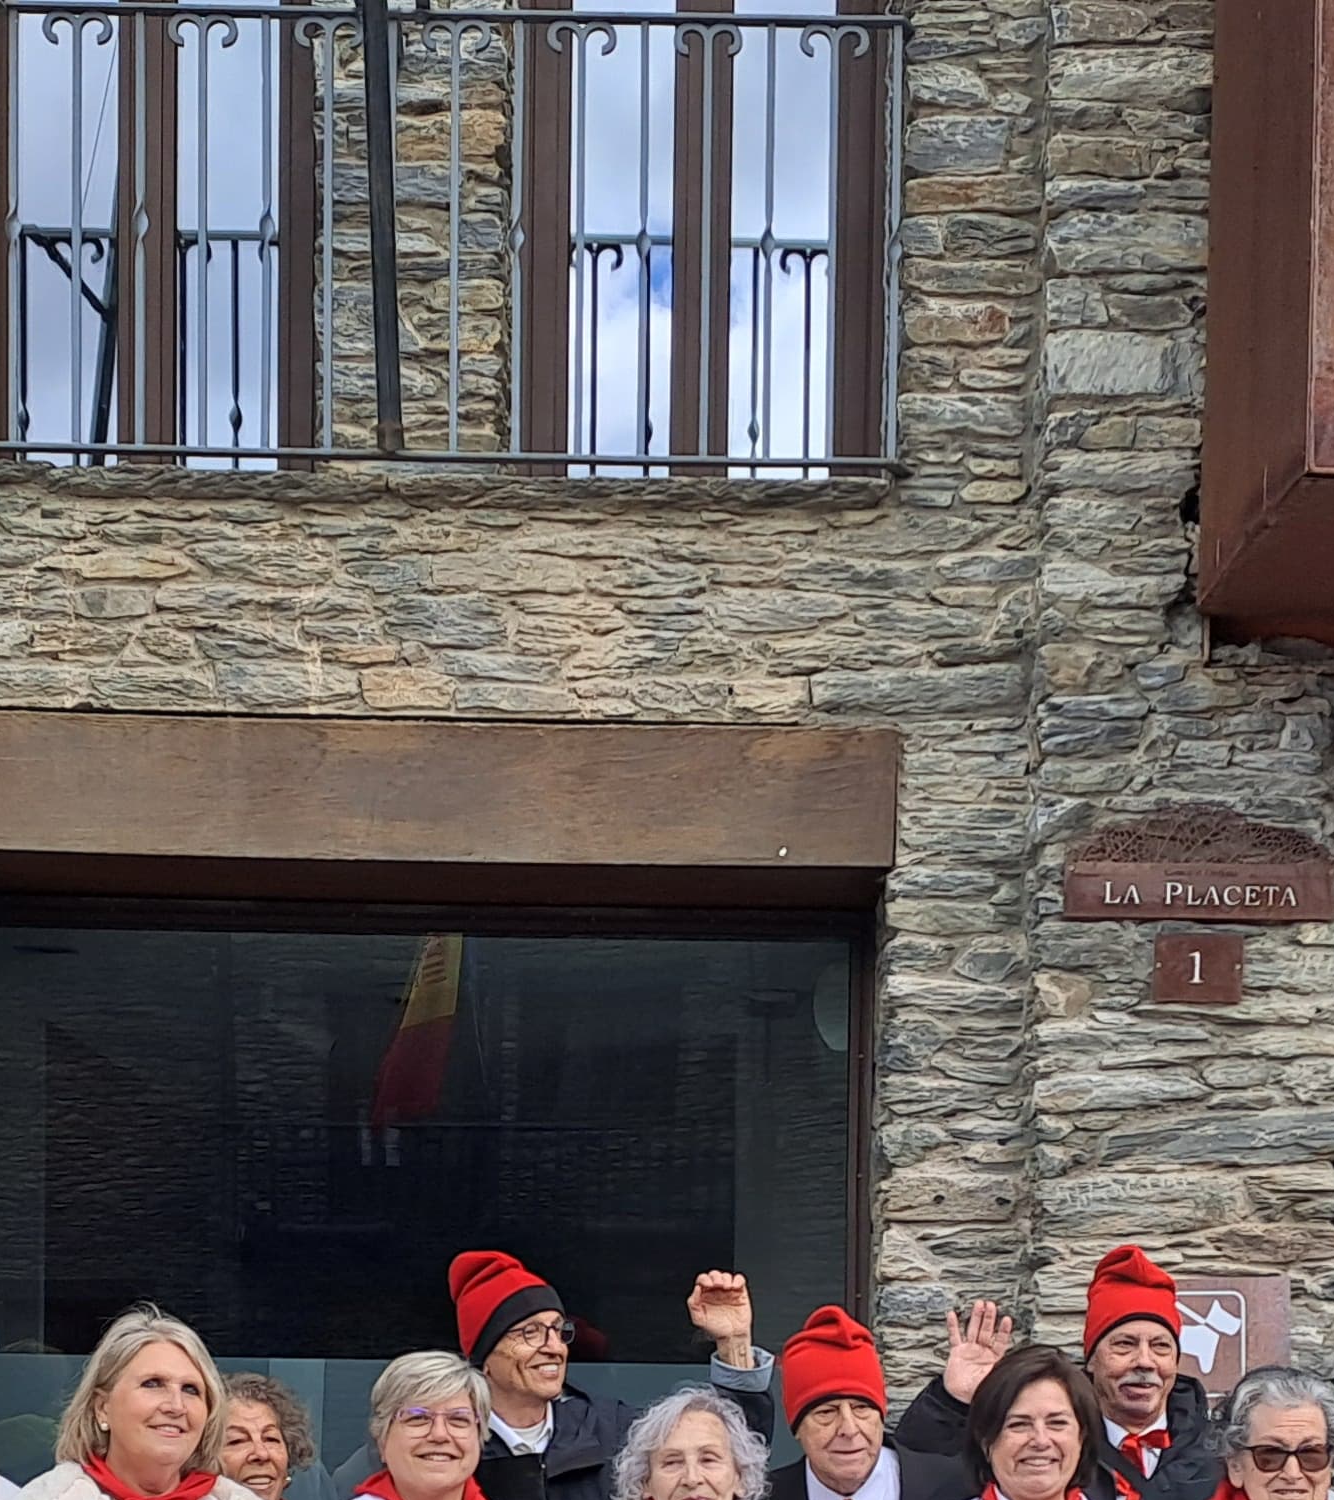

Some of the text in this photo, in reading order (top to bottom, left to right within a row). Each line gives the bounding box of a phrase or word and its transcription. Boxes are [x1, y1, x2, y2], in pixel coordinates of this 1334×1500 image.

[1103, 880, 1298, 907] LA PLACETA
[1187, 950, 1205, 984] 1
